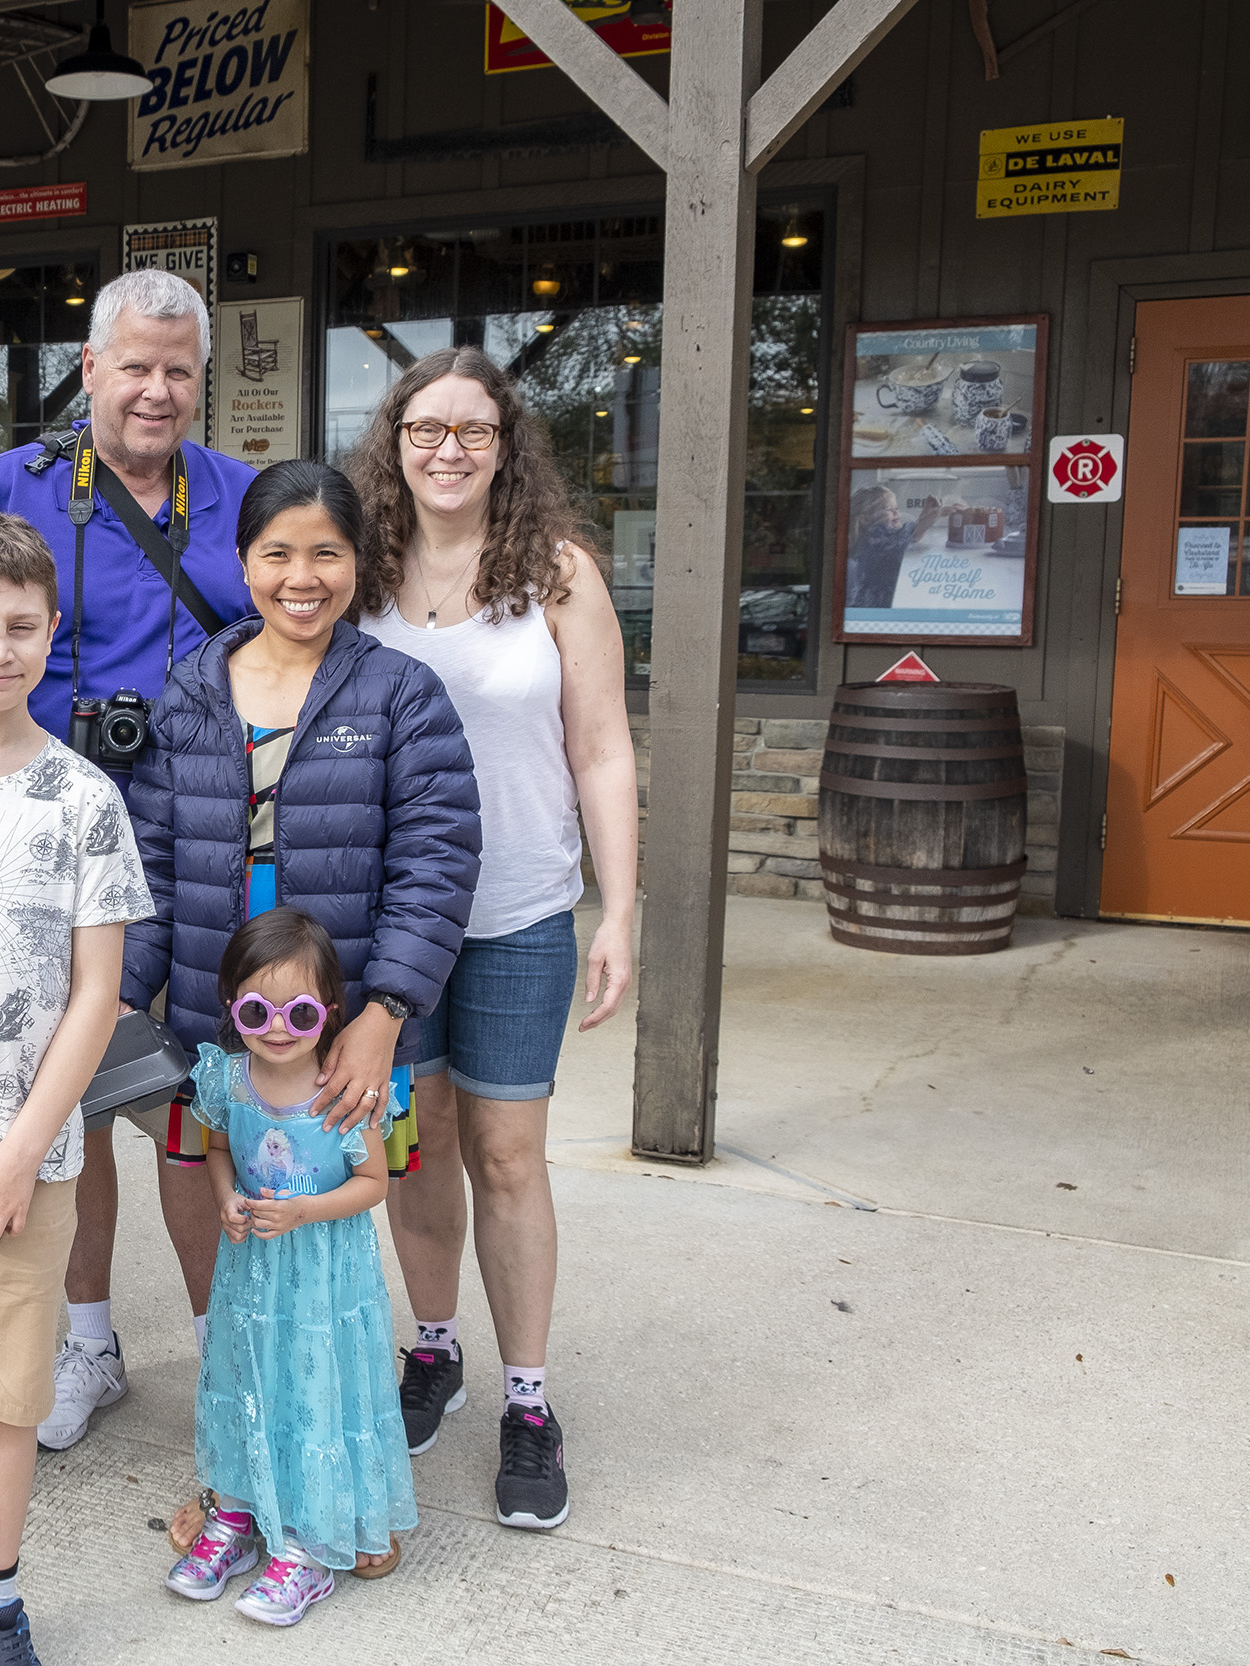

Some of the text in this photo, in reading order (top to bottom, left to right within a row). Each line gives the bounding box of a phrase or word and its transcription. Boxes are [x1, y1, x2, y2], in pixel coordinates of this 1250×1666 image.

[154, 0, 270, 64] Priced
[642, 32, 670, 41] Division
[137, 28, 298, 118] BELOW
[142, 91, 294, 158] Regular
[1015, 129, 1087, 144] WE USE
[1008, 150, 1118, 171] DE LAVAL
[1014, 179, 1082, 194] DAIRY
[36, 198, 80, 212] HEATING
[987, 191, 1110, 209] EQUIPMENT
[166, 249, 204, 271] GIVE
[903, 335, 980, 349] Country Living
[236, 388, 279, 397] All Of Our
[231, 399, 284, 411] Rockers
[230, 413, 285, 422] Are Available
[246, 425, 284, 433] Purchase
[77, 448, 92, 487] Nikon
[1077, 458, 1093, 480] R
[175, 475, 186, 516] Nikon
[921, 553, 970, 570] Make
[909, 568, 983, 588] Yourself
[928, 581, 996, 601] at Home
[118, 695, 137, 703] Nikon
[316, 734, 372, 743] UNIVERSAL
